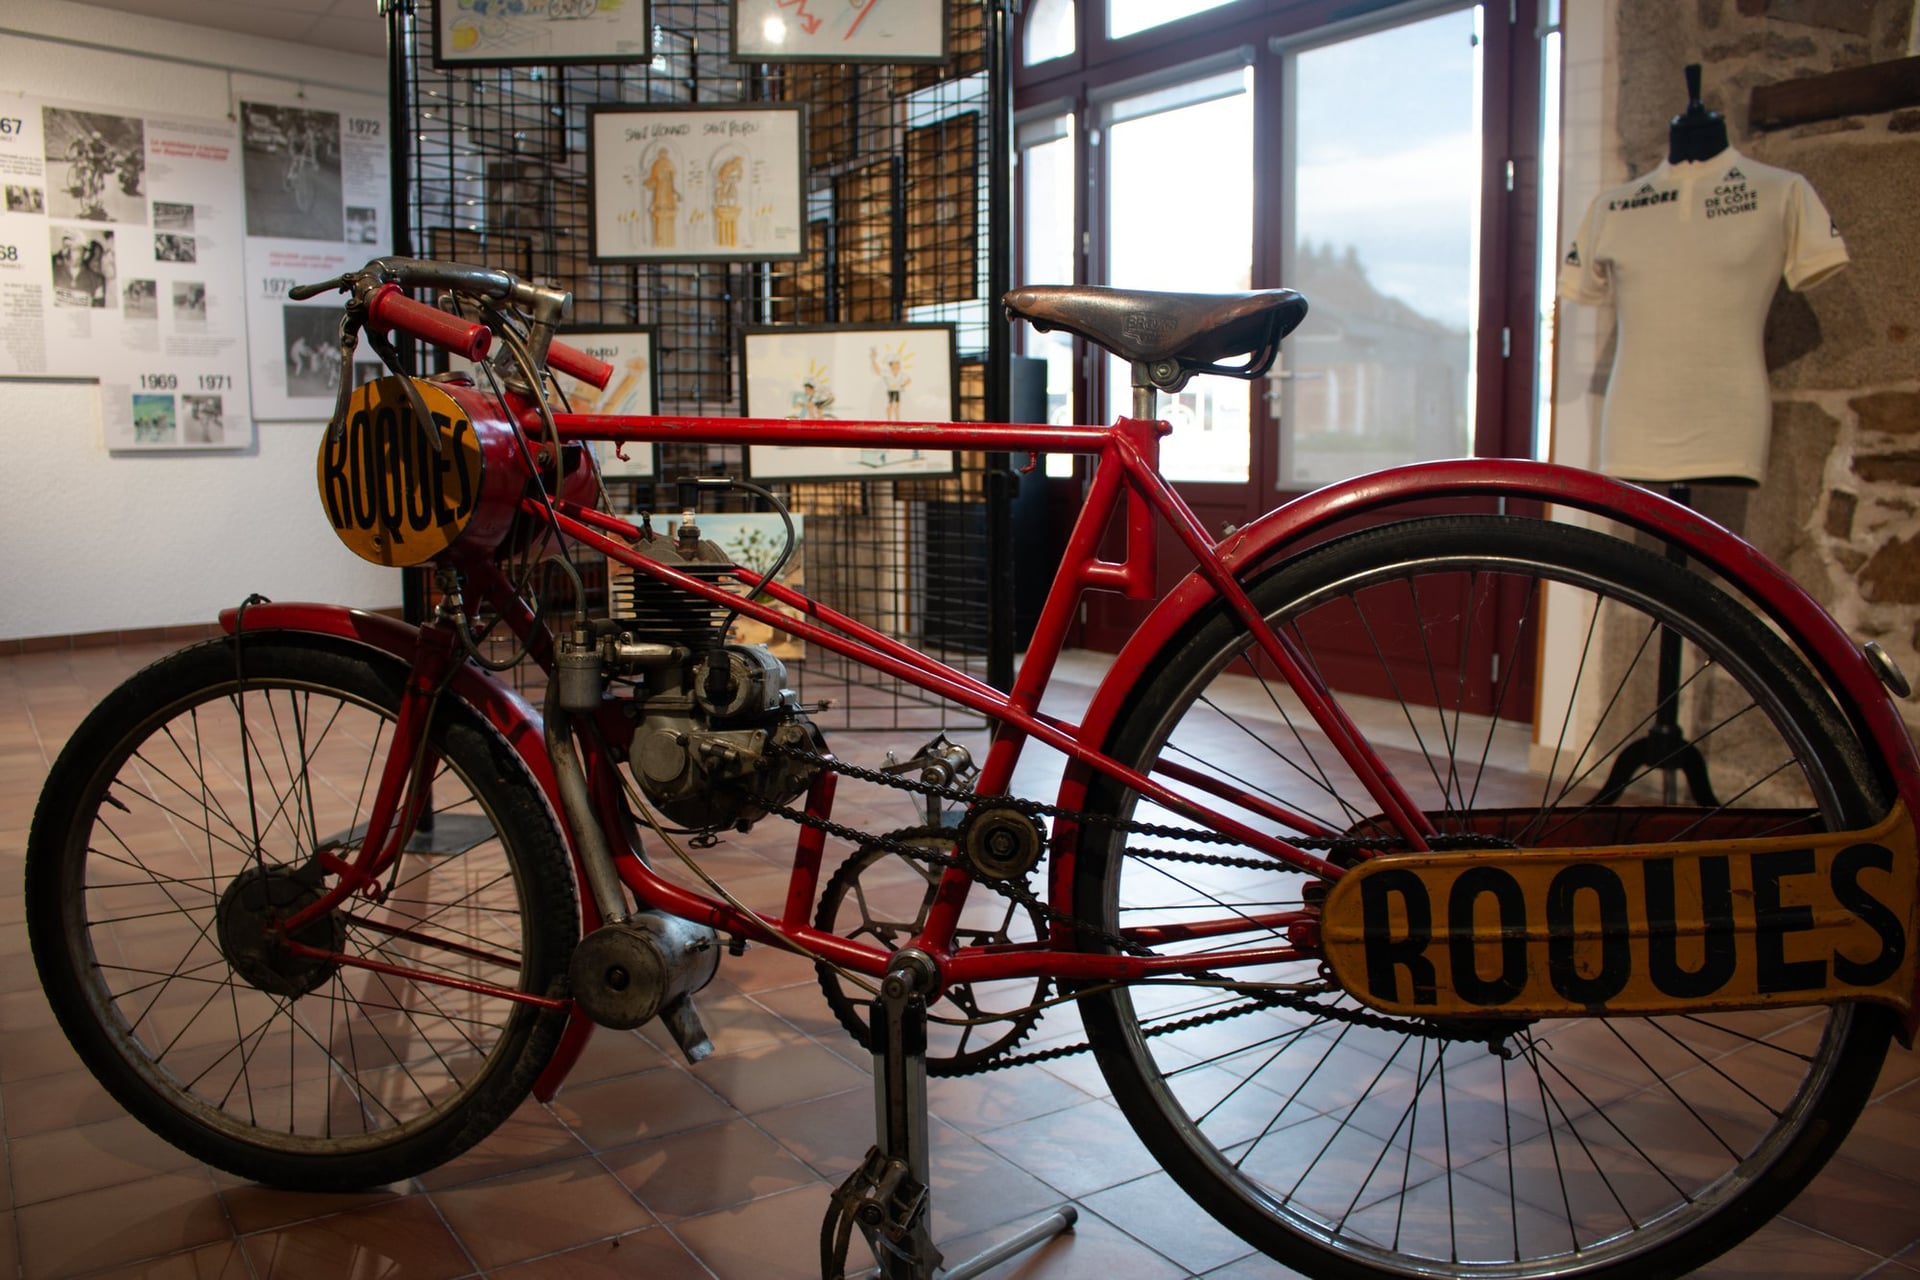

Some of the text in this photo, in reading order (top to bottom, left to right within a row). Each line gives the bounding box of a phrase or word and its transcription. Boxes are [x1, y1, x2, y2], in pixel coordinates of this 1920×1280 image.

[0, 118, 22, 135] 67
[1608, 189, 1679, 211] L'AURORE
[1705, 196, 1721, 209] DE
[1706, 201, 1758, 219] D'IVOIRE
[141, 374, 178, 390] 1969
[198, 374, 232, 391] 1971
[323, 406, 473, 544] ROQUES
[1360, 842, 1906, 1010] ROQUES
